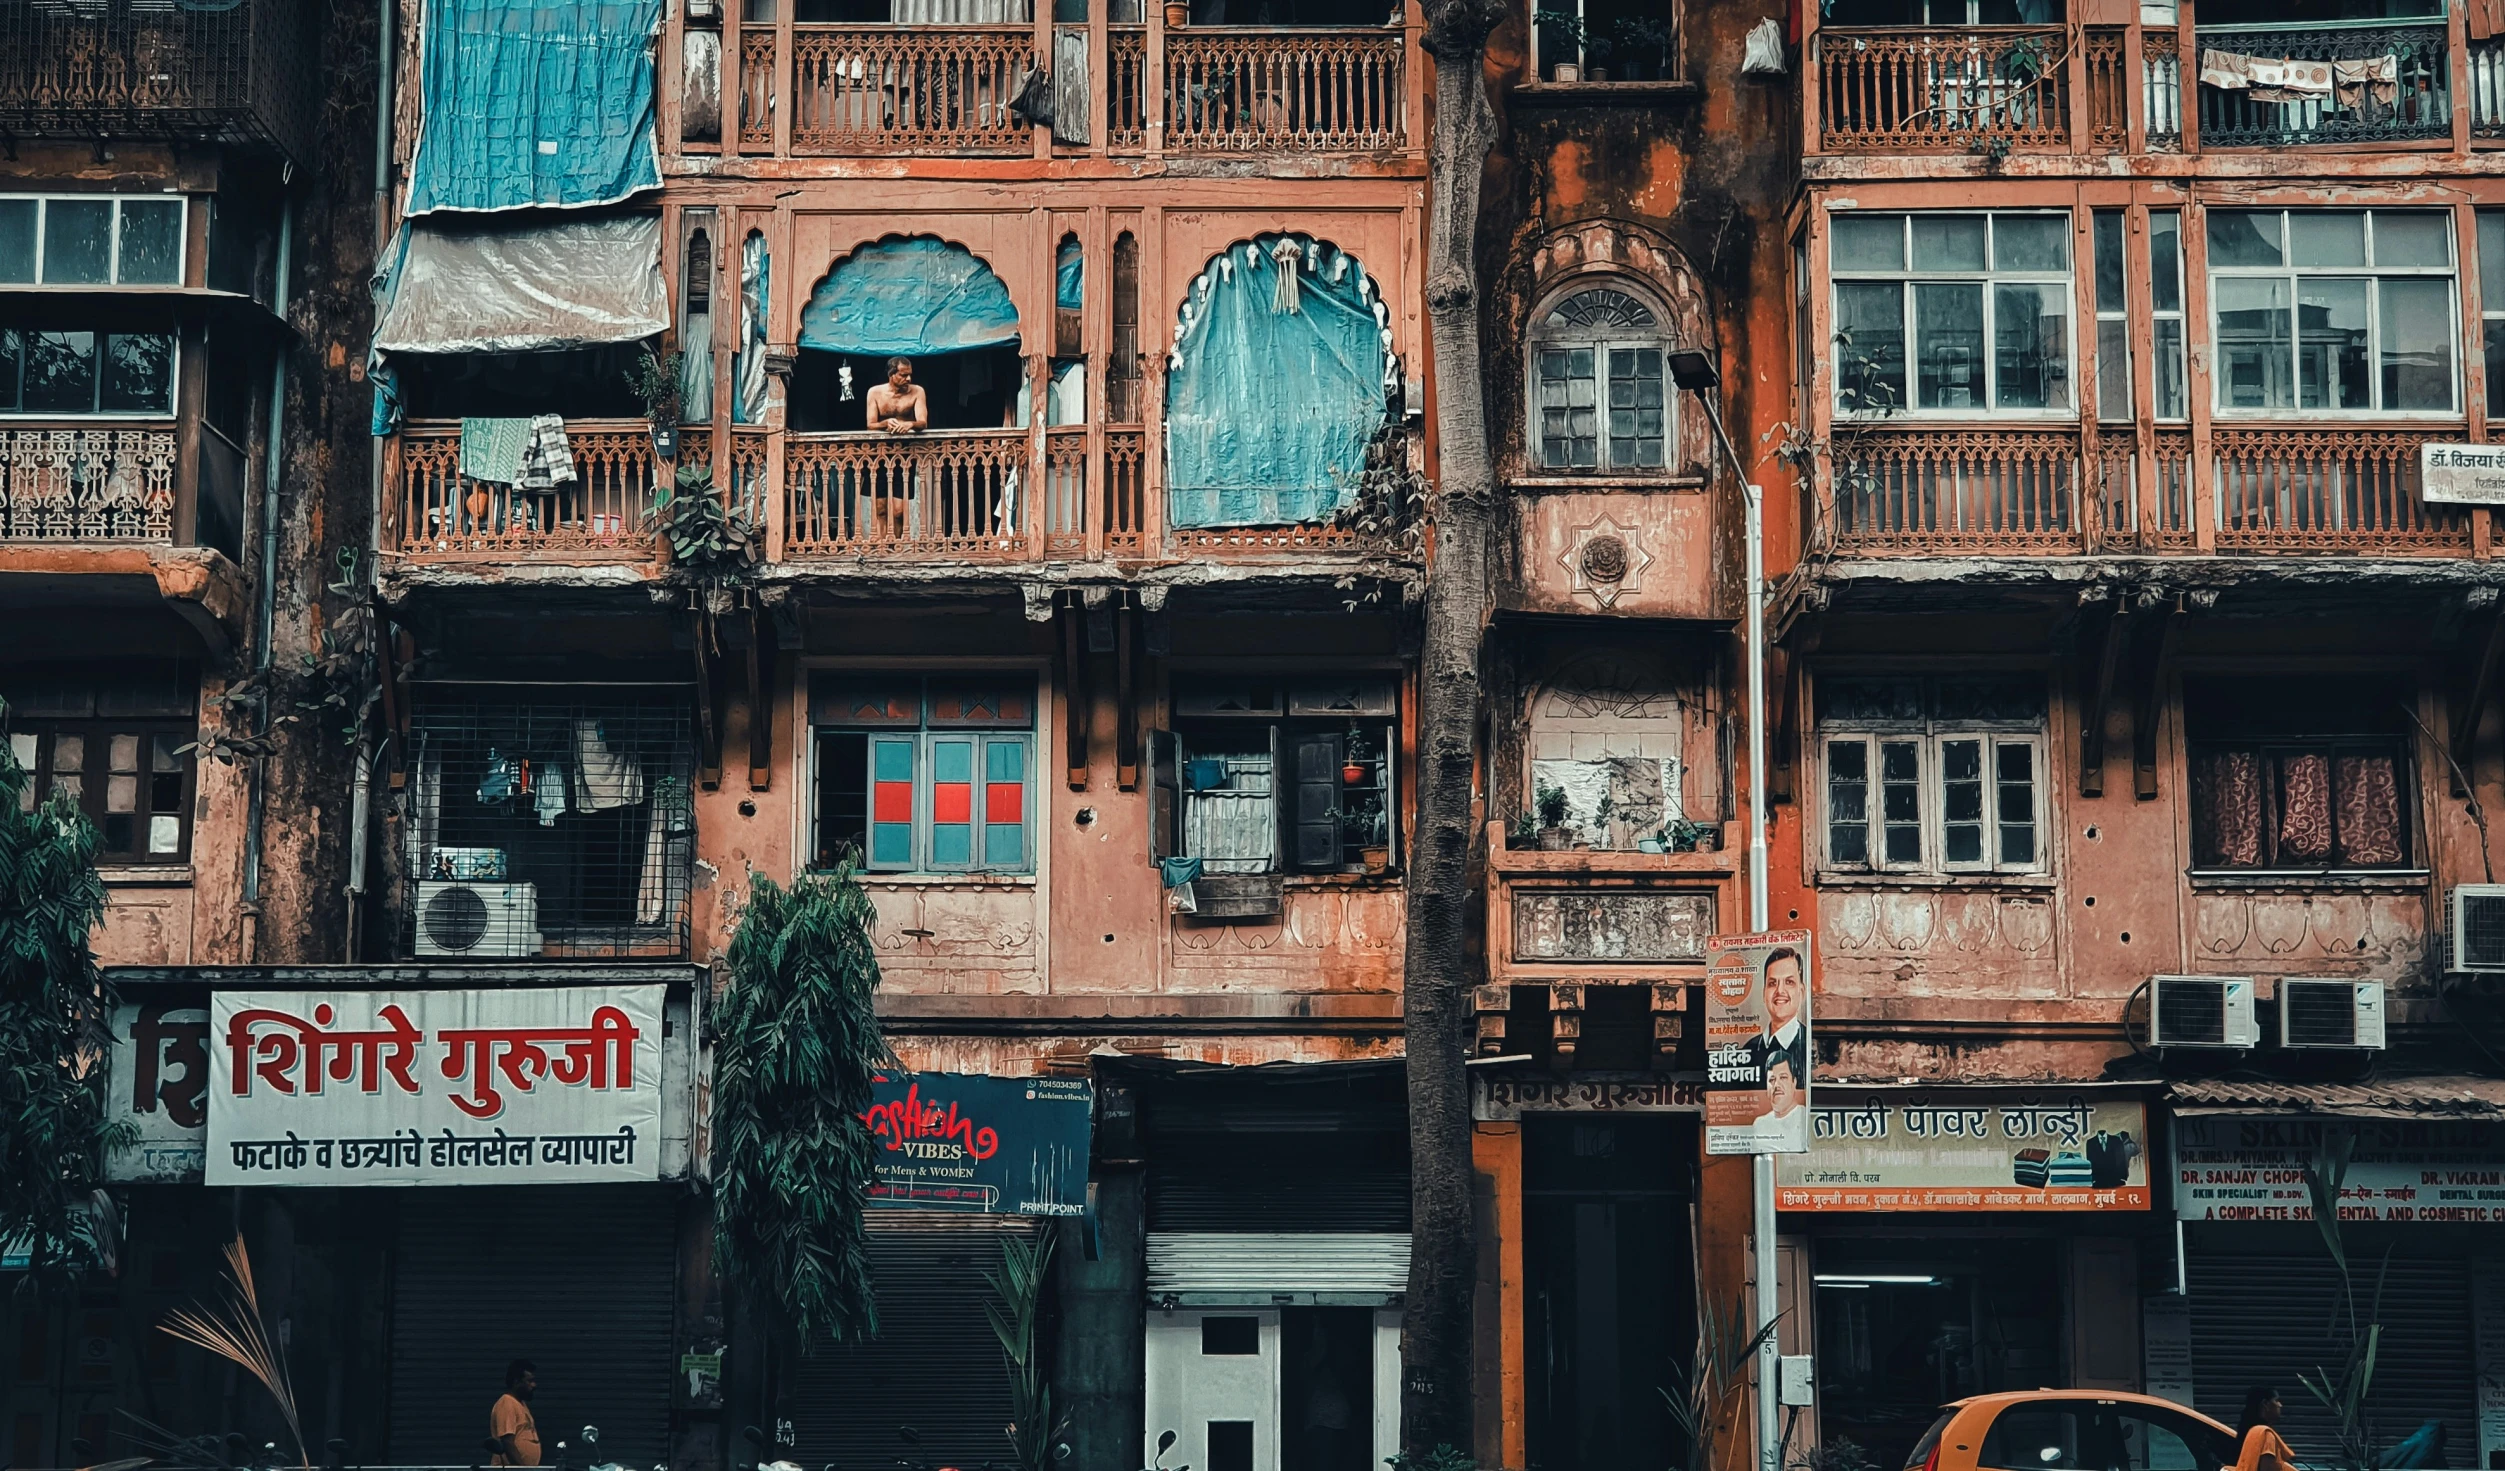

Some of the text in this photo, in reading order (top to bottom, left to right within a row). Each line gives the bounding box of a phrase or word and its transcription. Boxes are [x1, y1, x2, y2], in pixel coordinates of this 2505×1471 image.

[2430, 449, 2448, 467] डॉ.
[2450, 450, 2494, 468] विजया
[226, 1003, 424, 1096] शिंगरे
[437, 1005, 640, 1121] गुरुजी
[1708, 1043, 1752, 1068] हार्दिक
[1708, 1066, 1761, 1083] स्वागत!
[1811, 1095, 1892, 1139] ताली
[1903, 1095, 1989, 1138] पॉवर
[231, 1131, 309, 1171] फटाके
[314, 1138, 337, 1168] व
[430, 1127, 535, 1169] होलसेल
[540, 1126, 637, 1166] व्यापारी
[2349, 1151, 2391, 1163] EALTHY
[918, 1166, 927, 1176] &
[930, 1166, 974, 1178] WOMEN
[1804, 1171, 1881, 1184] प्रो. मोनाली वि. परब
[2181, 1170, 2204, 1184] DR.
[2206, 1170, 2258, 1184] SANJAY
[2421, 1171, 2443, 1185] DR.
[2446, 1171, 2500, 1185] VIKRAM
[1783, 1190, 1809, 1205] शिंगरे
[1874, 1194, 1899, 1209] दुकान
[2094, 1189, 2117, 1208] मुंबई
[2193, 1189, 2214, 1199] SKIN
[2217, 1189, 2269, 1199] SPECIALIST
[2439, 1189, 2474, 1200] DENTAL
[1052, 1204, 1084, 1215] POINT
[2205, 1207, 2214, 1220] A
[2219, 1206, 2288, 1220] COMPLETE
[2293, 1207, 2315, 1220] SKI
[2337, 1207, 2380, 1220] ENTAL
[2386, 1207, 2414, 1220] AND
[2419, 1207, 2488, 1221] COSMETIC
